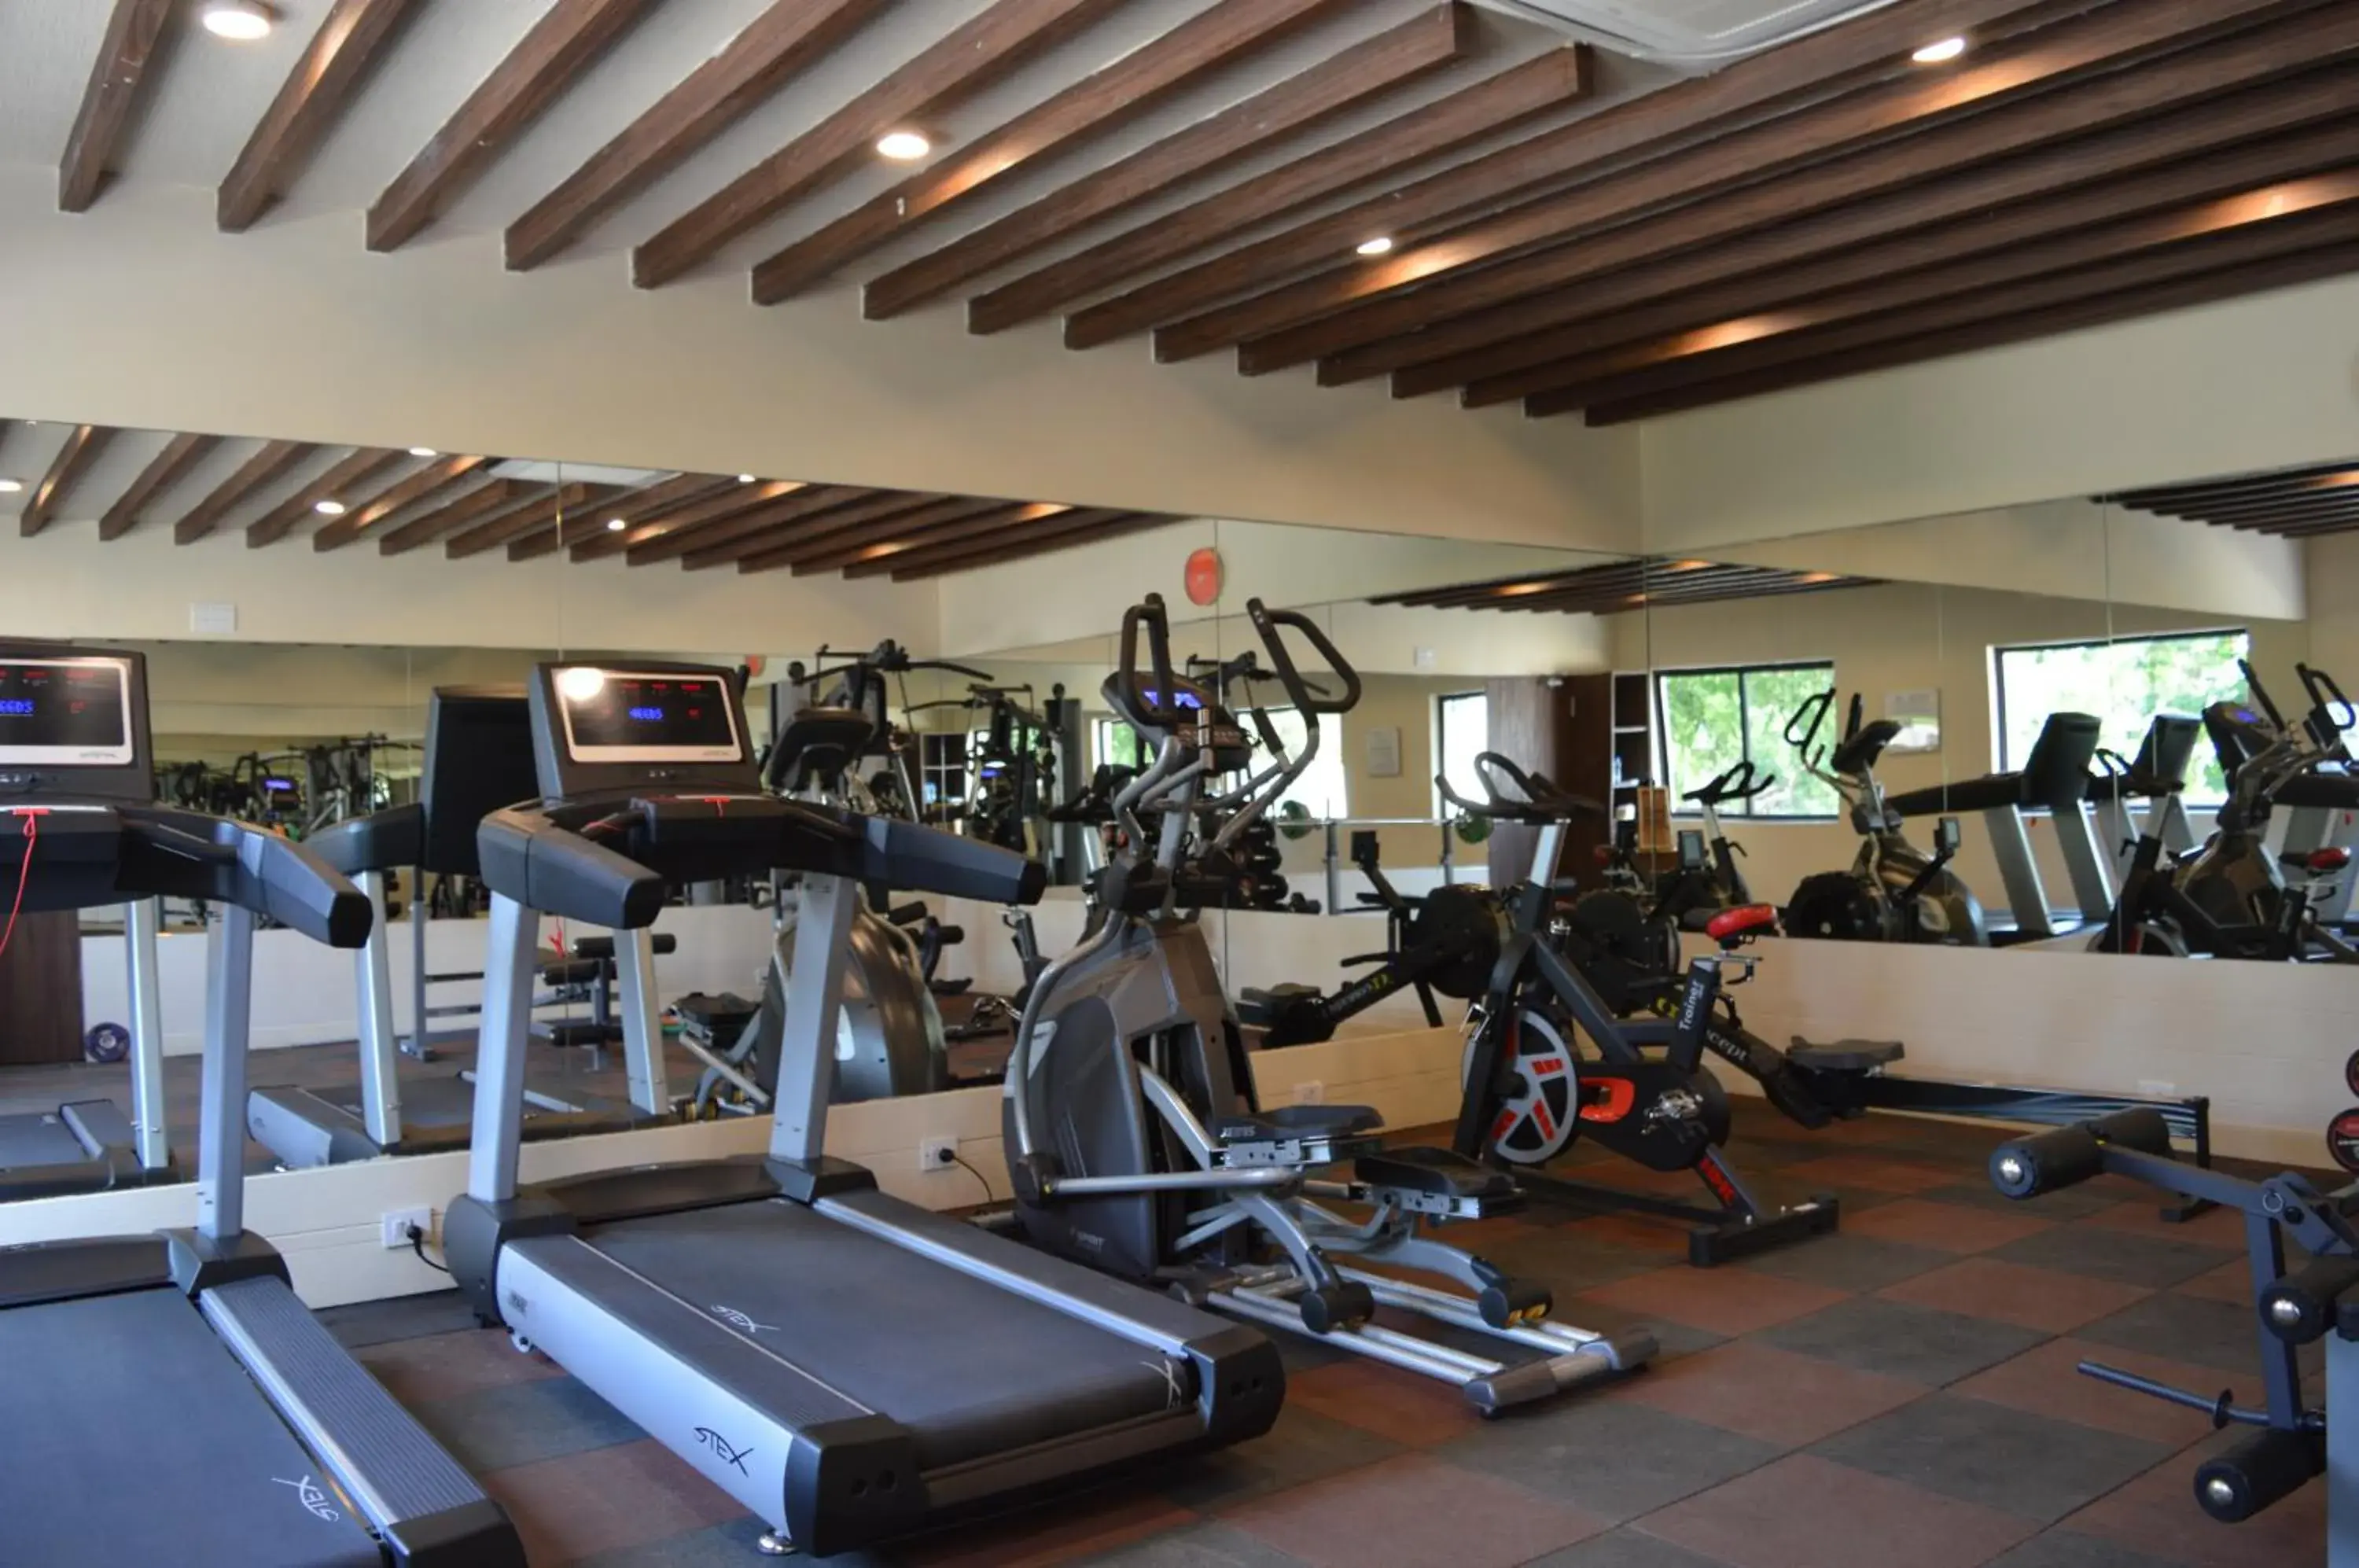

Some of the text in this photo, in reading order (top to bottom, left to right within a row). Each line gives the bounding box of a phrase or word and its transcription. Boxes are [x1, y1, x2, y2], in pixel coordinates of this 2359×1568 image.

[1678, 979, 1700, 1031] Trainer
[711, 1305, 781, 1334] STEX
[694, 1426, 755, 1478] STEX
[270, 1474, 340, 1522] STEX
